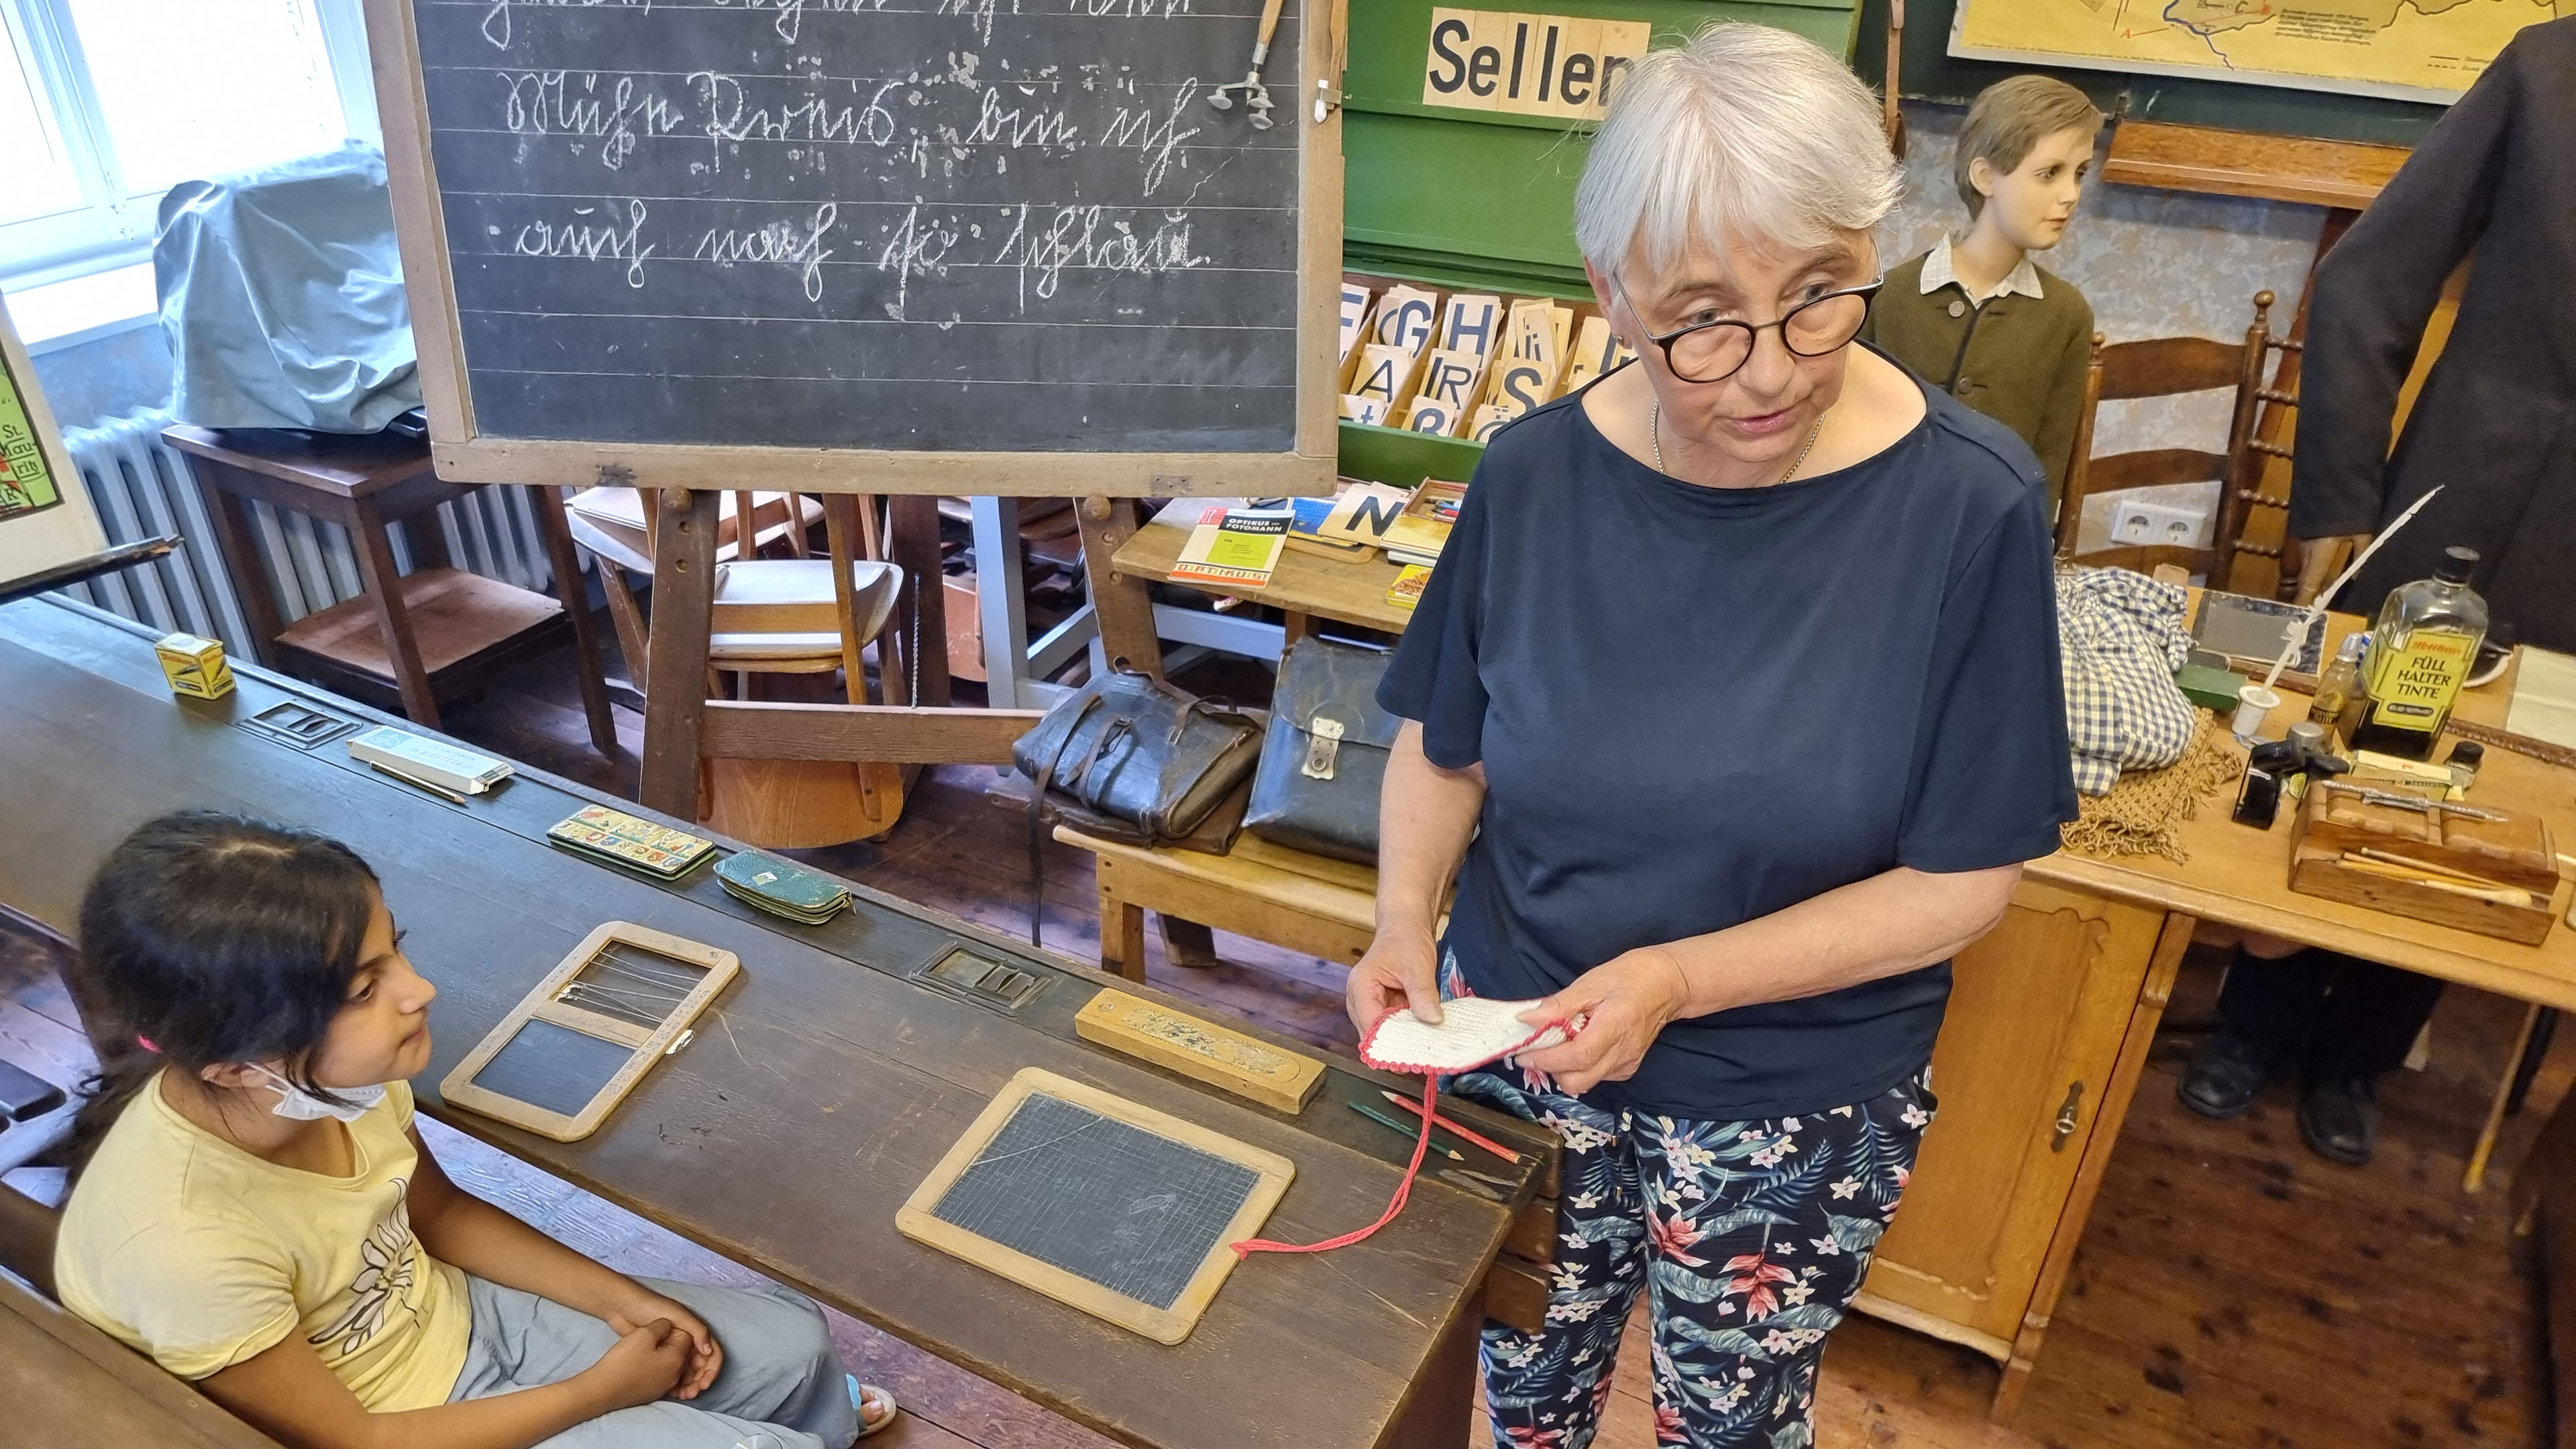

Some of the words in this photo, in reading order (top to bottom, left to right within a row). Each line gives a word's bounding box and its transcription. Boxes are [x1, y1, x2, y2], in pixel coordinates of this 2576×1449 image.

[1448, 303, 1494, 369] H
[1355, 359, 1393, 404] A
[1504, 366, 1543, 415] S
[1228, 518, 1270, 527] OPTIKUS
[1344, 495, 1406, 537] N
[2397, 669, 2452, 686] HALTER
[2412, 655, 2446, 672] FÜLL
[2397, 683, 2441, 699] TINTE
